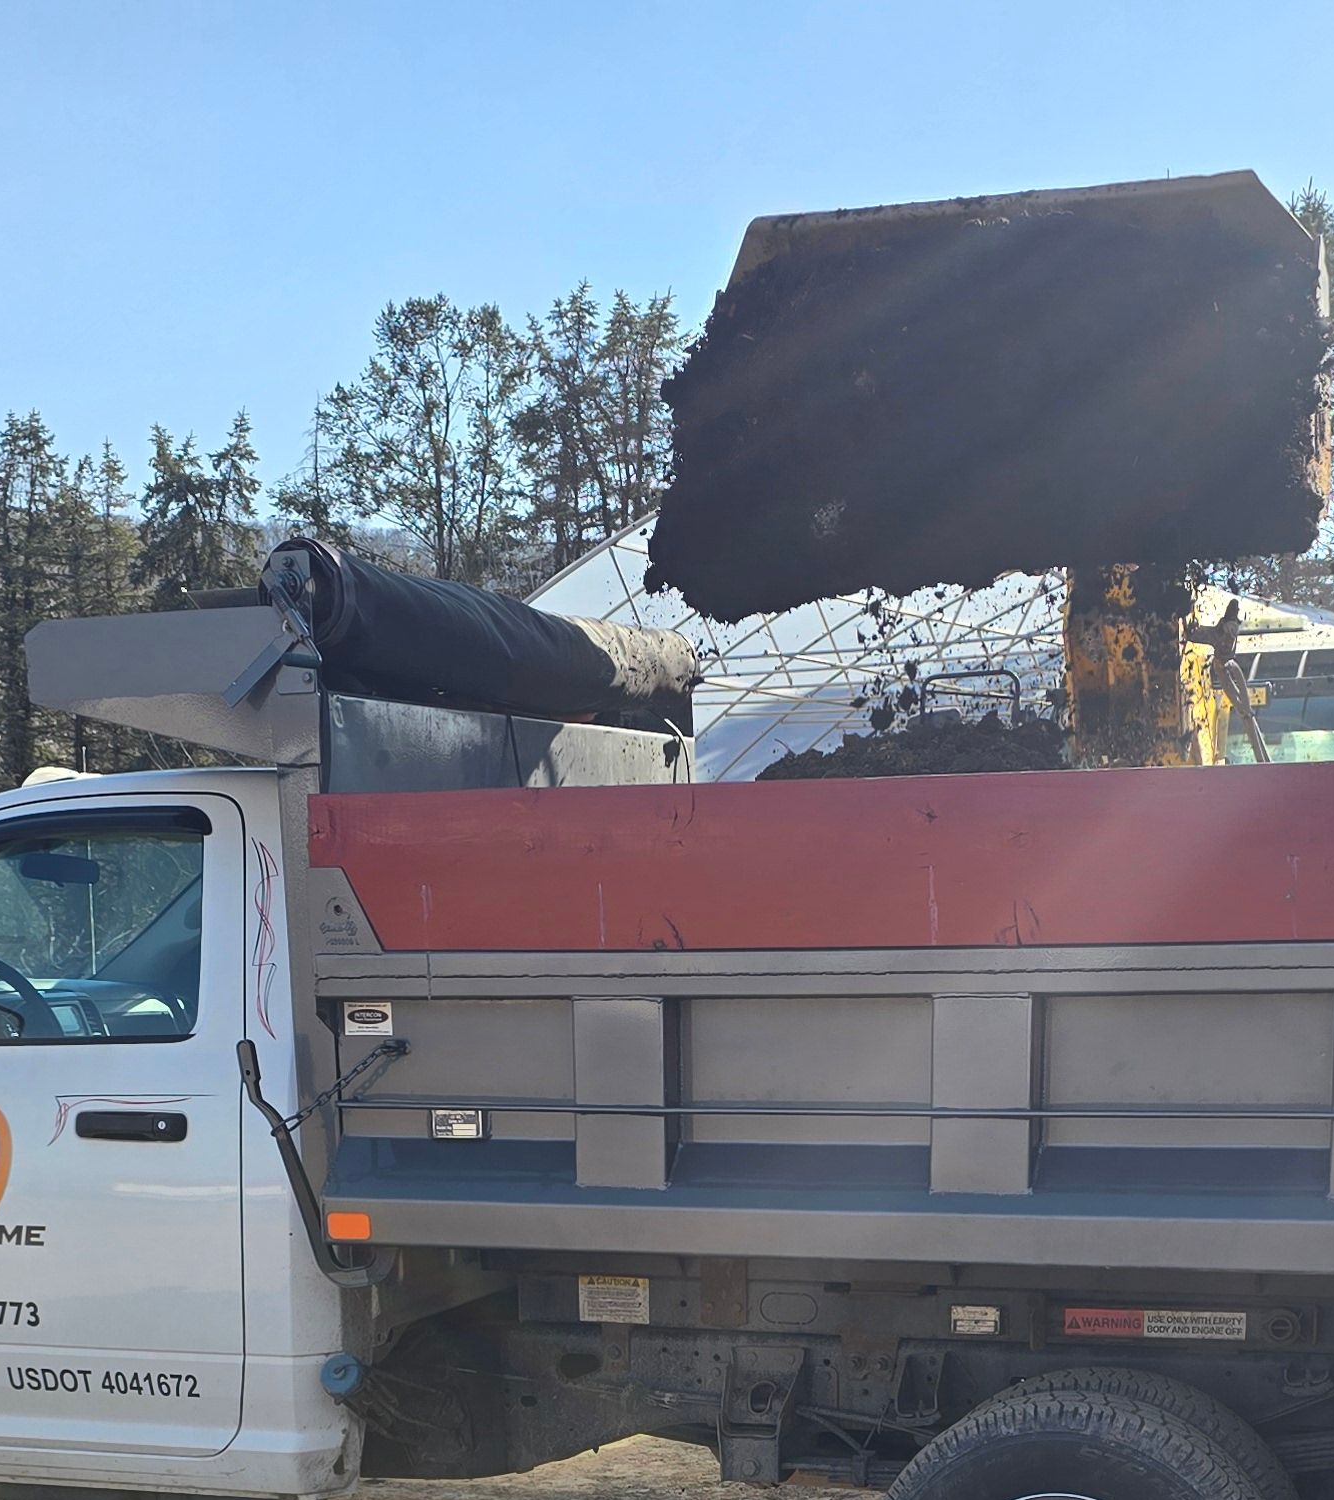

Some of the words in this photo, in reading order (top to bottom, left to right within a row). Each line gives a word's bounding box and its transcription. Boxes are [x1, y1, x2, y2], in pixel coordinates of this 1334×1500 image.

[596, 1276, 631, 1286] CAUTION
[1081, 1317, 1142, 1329] WARNING
[1147, 1315, 1166, 1324] USE
[1166, 1316, 1190, 1324] ONLY
[1190, 1316, 1212, 1325] WITH
[1213, 1317, 1244, 1326] EMPTY
[1146, 1325, 1170, 1334] BODY
[1171, 1326, 1190, 1334] AND
[1191, 1326, 1224, 1335] ENGINE
[1225, 1327, 1244, 1336] OFF
[7, 1366, 92, 1393] USDOT
[101, 1370, 201, 1398] 4041672
